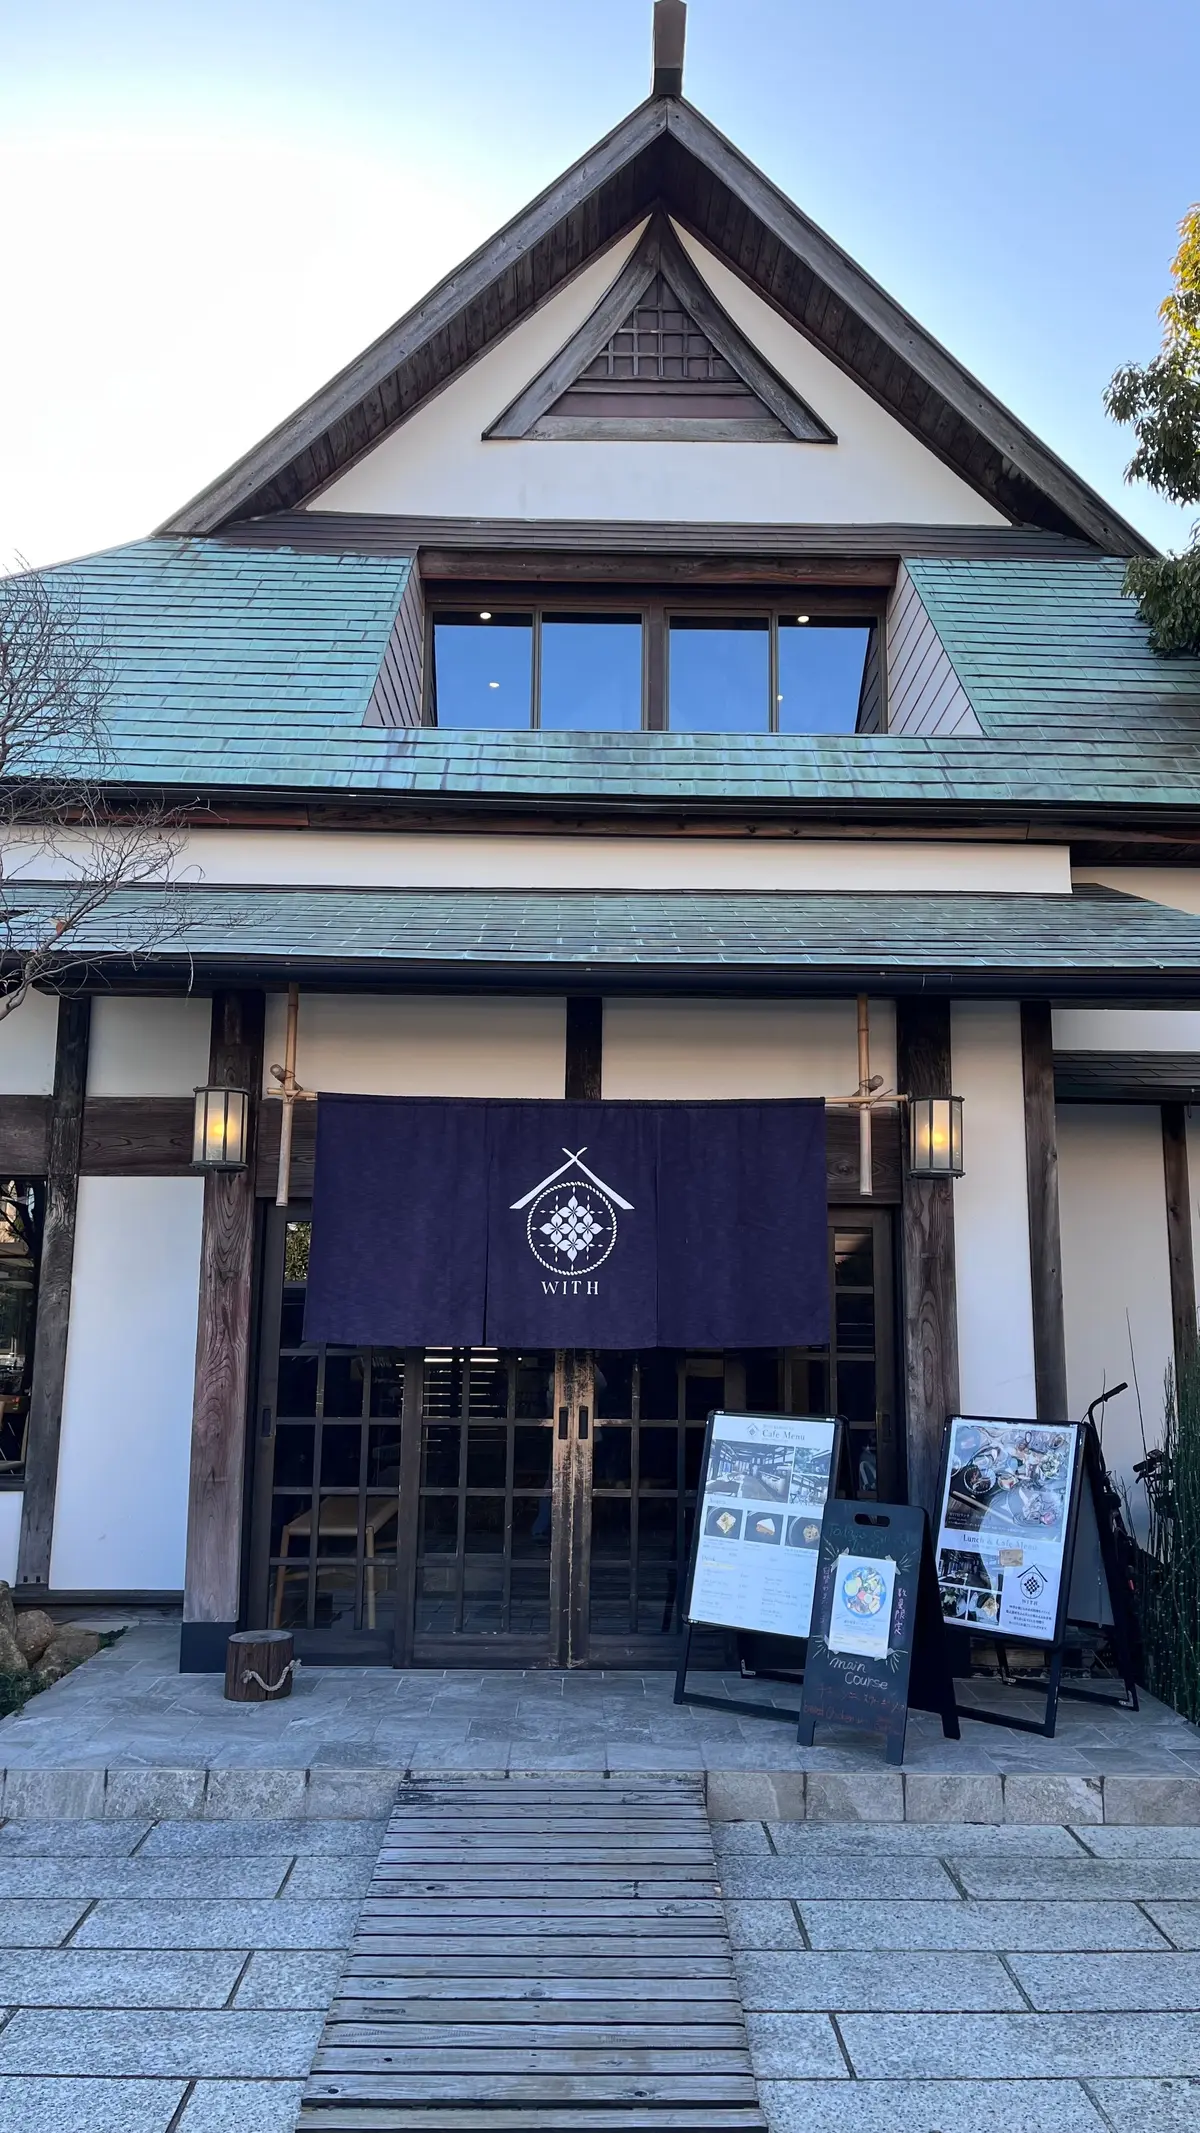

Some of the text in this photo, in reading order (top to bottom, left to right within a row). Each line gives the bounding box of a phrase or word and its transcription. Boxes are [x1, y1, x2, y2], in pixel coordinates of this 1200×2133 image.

[541, 1280, 599, 1295] WITH
[762, 1429, 805, 1441] Cafe Menu
[963, 1534, 984, 1544] Lunch
[996, 1538, 1013, 1548] Cafe
[1016, 1540, 1038, 1551] Menu
[844, 1671, 888, 1690] Course
